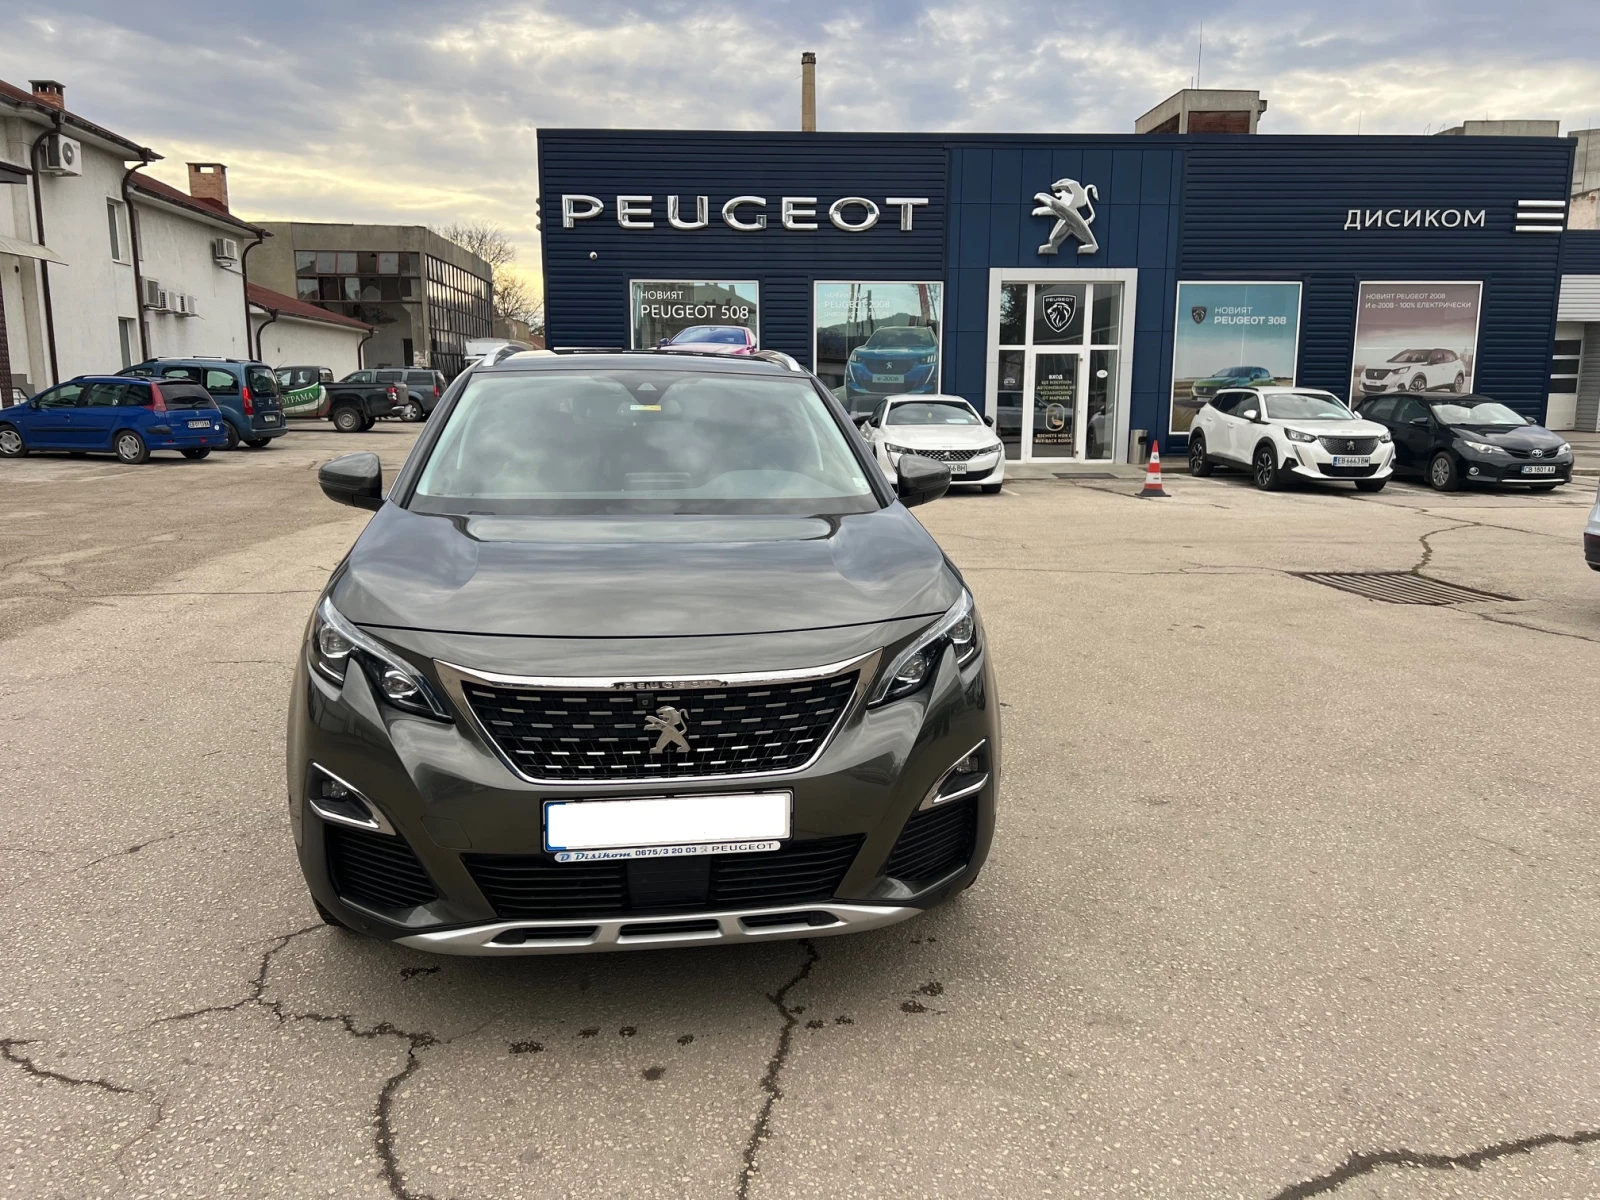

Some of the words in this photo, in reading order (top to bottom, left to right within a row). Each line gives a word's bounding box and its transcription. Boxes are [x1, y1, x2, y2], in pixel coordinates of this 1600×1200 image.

[561, 194, 929, 232] PEUGEOT
[1343, 209, 1486, 230] ДИСИКОМ
[640, 290, 684, 300] НОВИЯТ
[824, 300, 867, 309] PEUGEOT
[869, 300, 891, 308] 2008
[1416, 301, 1472, 309] ЕЛЕКТРИЧЕСКИ
[640, 304, 717, 318] PEUGEOT
[721, 306, 749, 319] 508
[1214, 306, 1253, 315] НОВИЯТ
[1214, 316, 1266, 325] PEUGEOT
[1267, 316, 1287, 325] 308
[624, 680, 713, 690] PEUGEOT
[711, 842, 775, 852] PEUGEOT
[574, 852, 633, 861] Disikom
[635, 848, 669, 857] 0675/3
